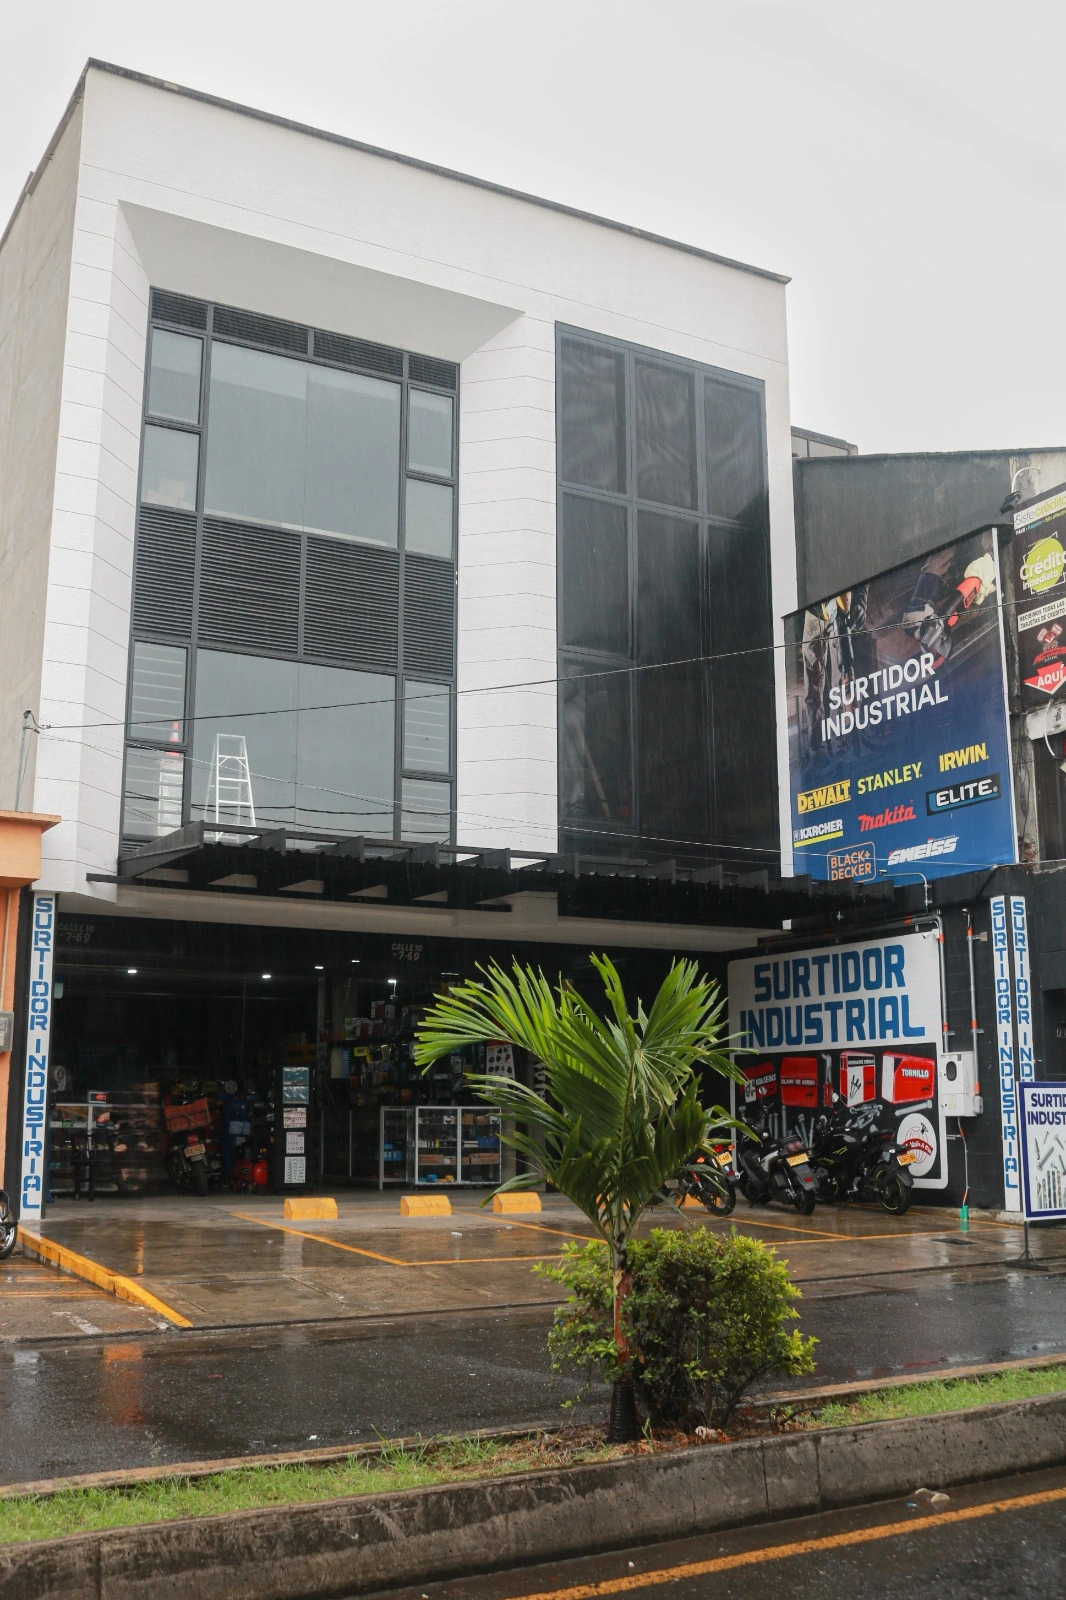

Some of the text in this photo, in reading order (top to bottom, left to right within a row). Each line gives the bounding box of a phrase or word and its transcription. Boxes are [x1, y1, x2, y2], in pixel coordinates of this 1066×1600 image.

[829, 652, 936, 711] SURTIDOR
[821, 680, 949, 741] INDUSTRIAL
[857, 761, 922, 795] STANLEY
[939, 742, 989, 773] IRWIN
[831, 862, 872, 882] DECKER
[754, 944, 906, 1003] SURTIDOR
[1011, 901, 1031, 1025] SURTIDOR
[740, 994, 926, 1049] INDUSTRIAL
[991, 901, 1019, 1189] SURTIDOR INDUSTRIAL
[22, 897, 55, 1209] SURTIDOR INDUSTRIAL
[901, 1068, 930, 1080] TORNILLO
[1027, 1110, 1066, 1126] INDUST
